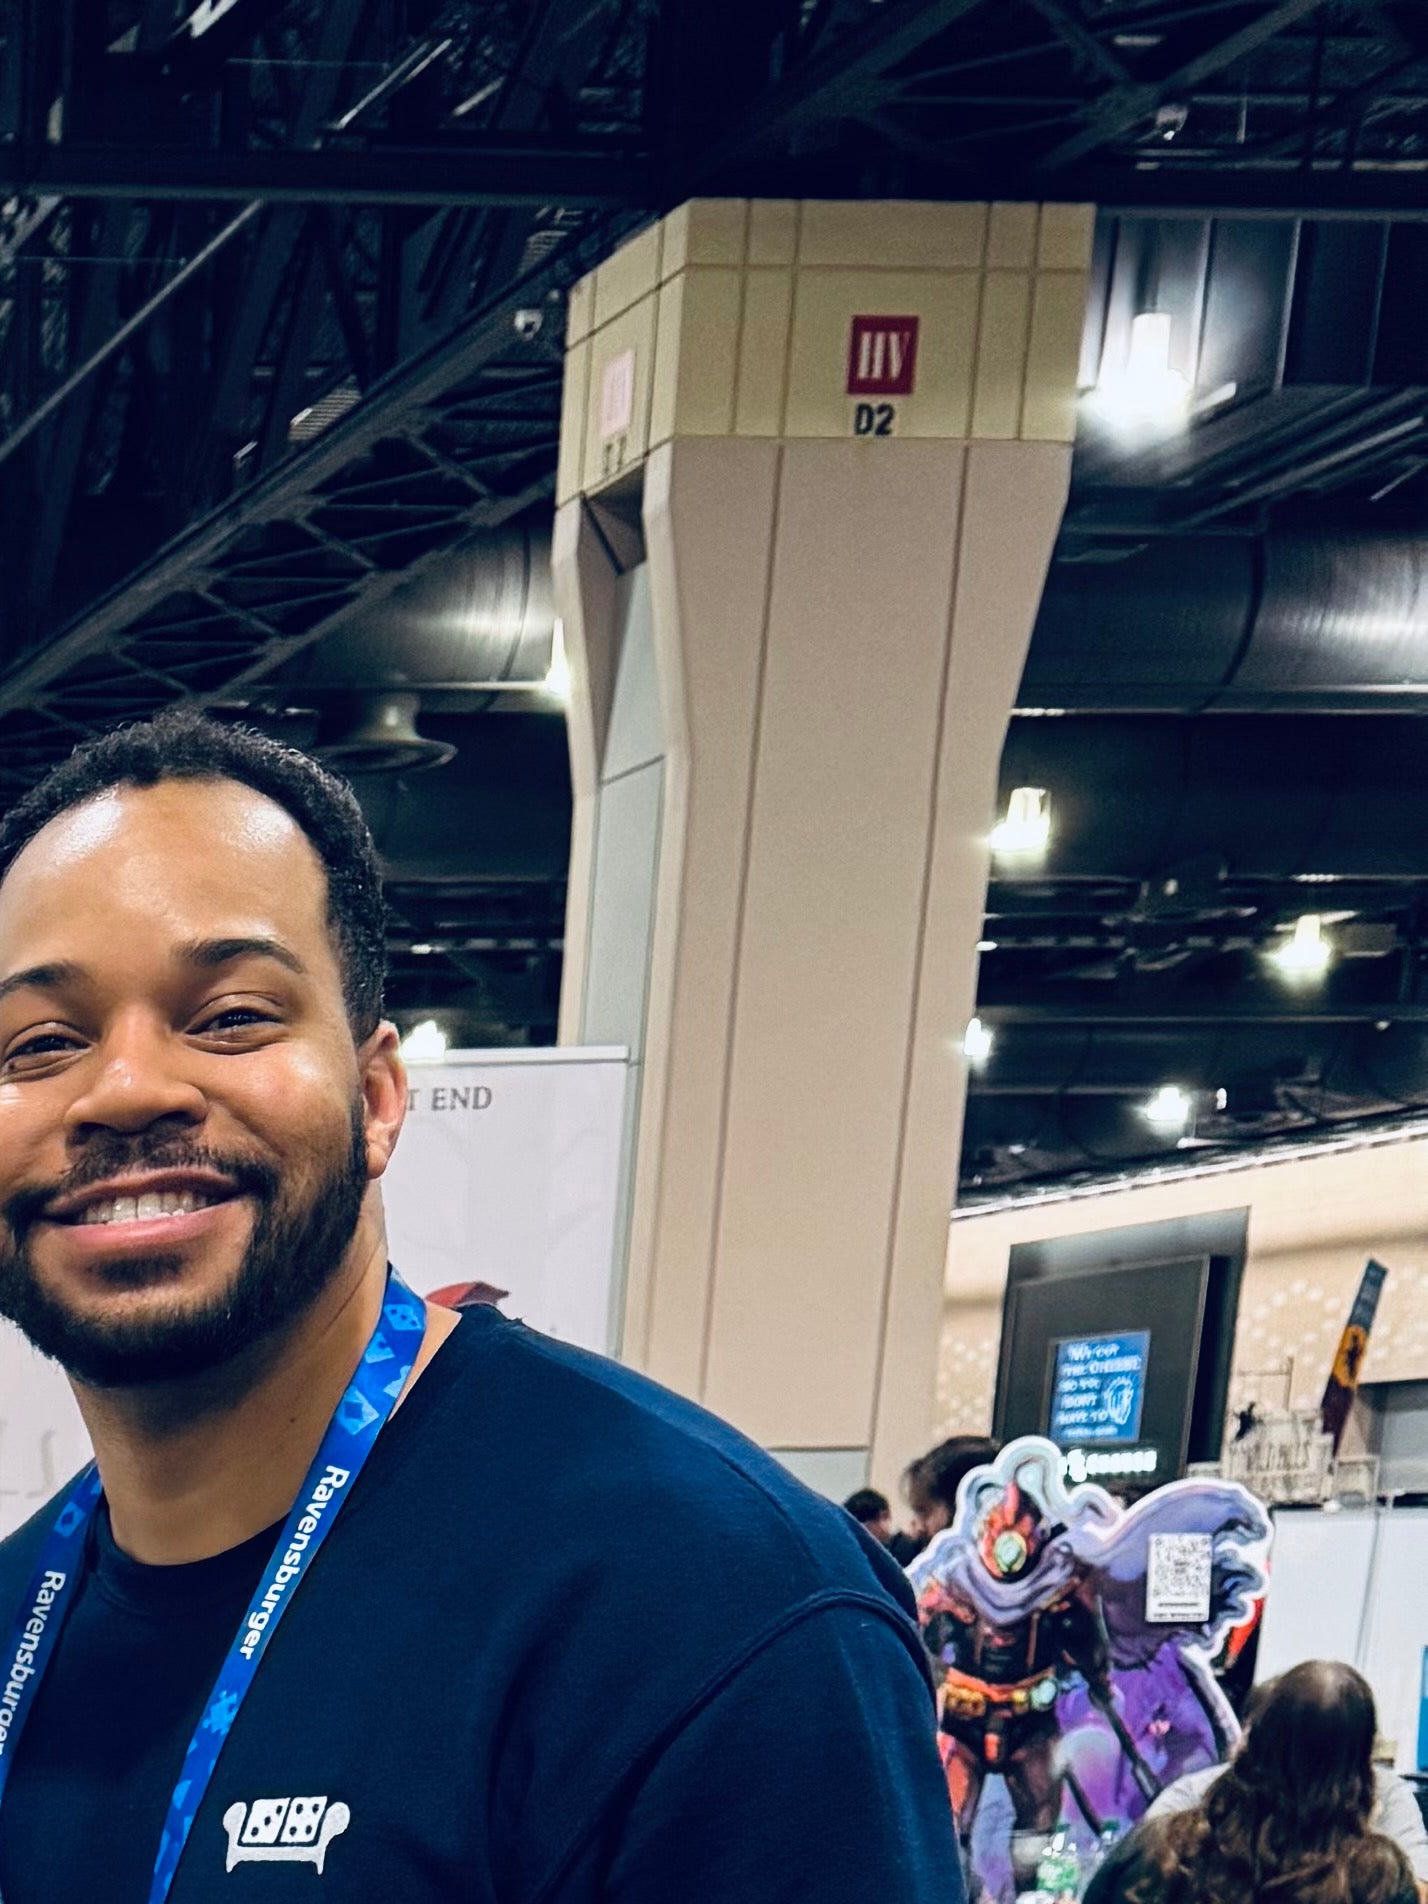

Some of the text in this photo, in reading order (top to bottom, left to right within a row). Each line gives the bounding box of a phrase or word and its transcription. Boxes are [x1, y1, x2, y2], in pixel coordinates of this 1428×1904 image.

[855, 402, 894, 436] D2
[431, 1085, 493, 1111] END
[240, 1464, 350, 1660] Ravensburger
